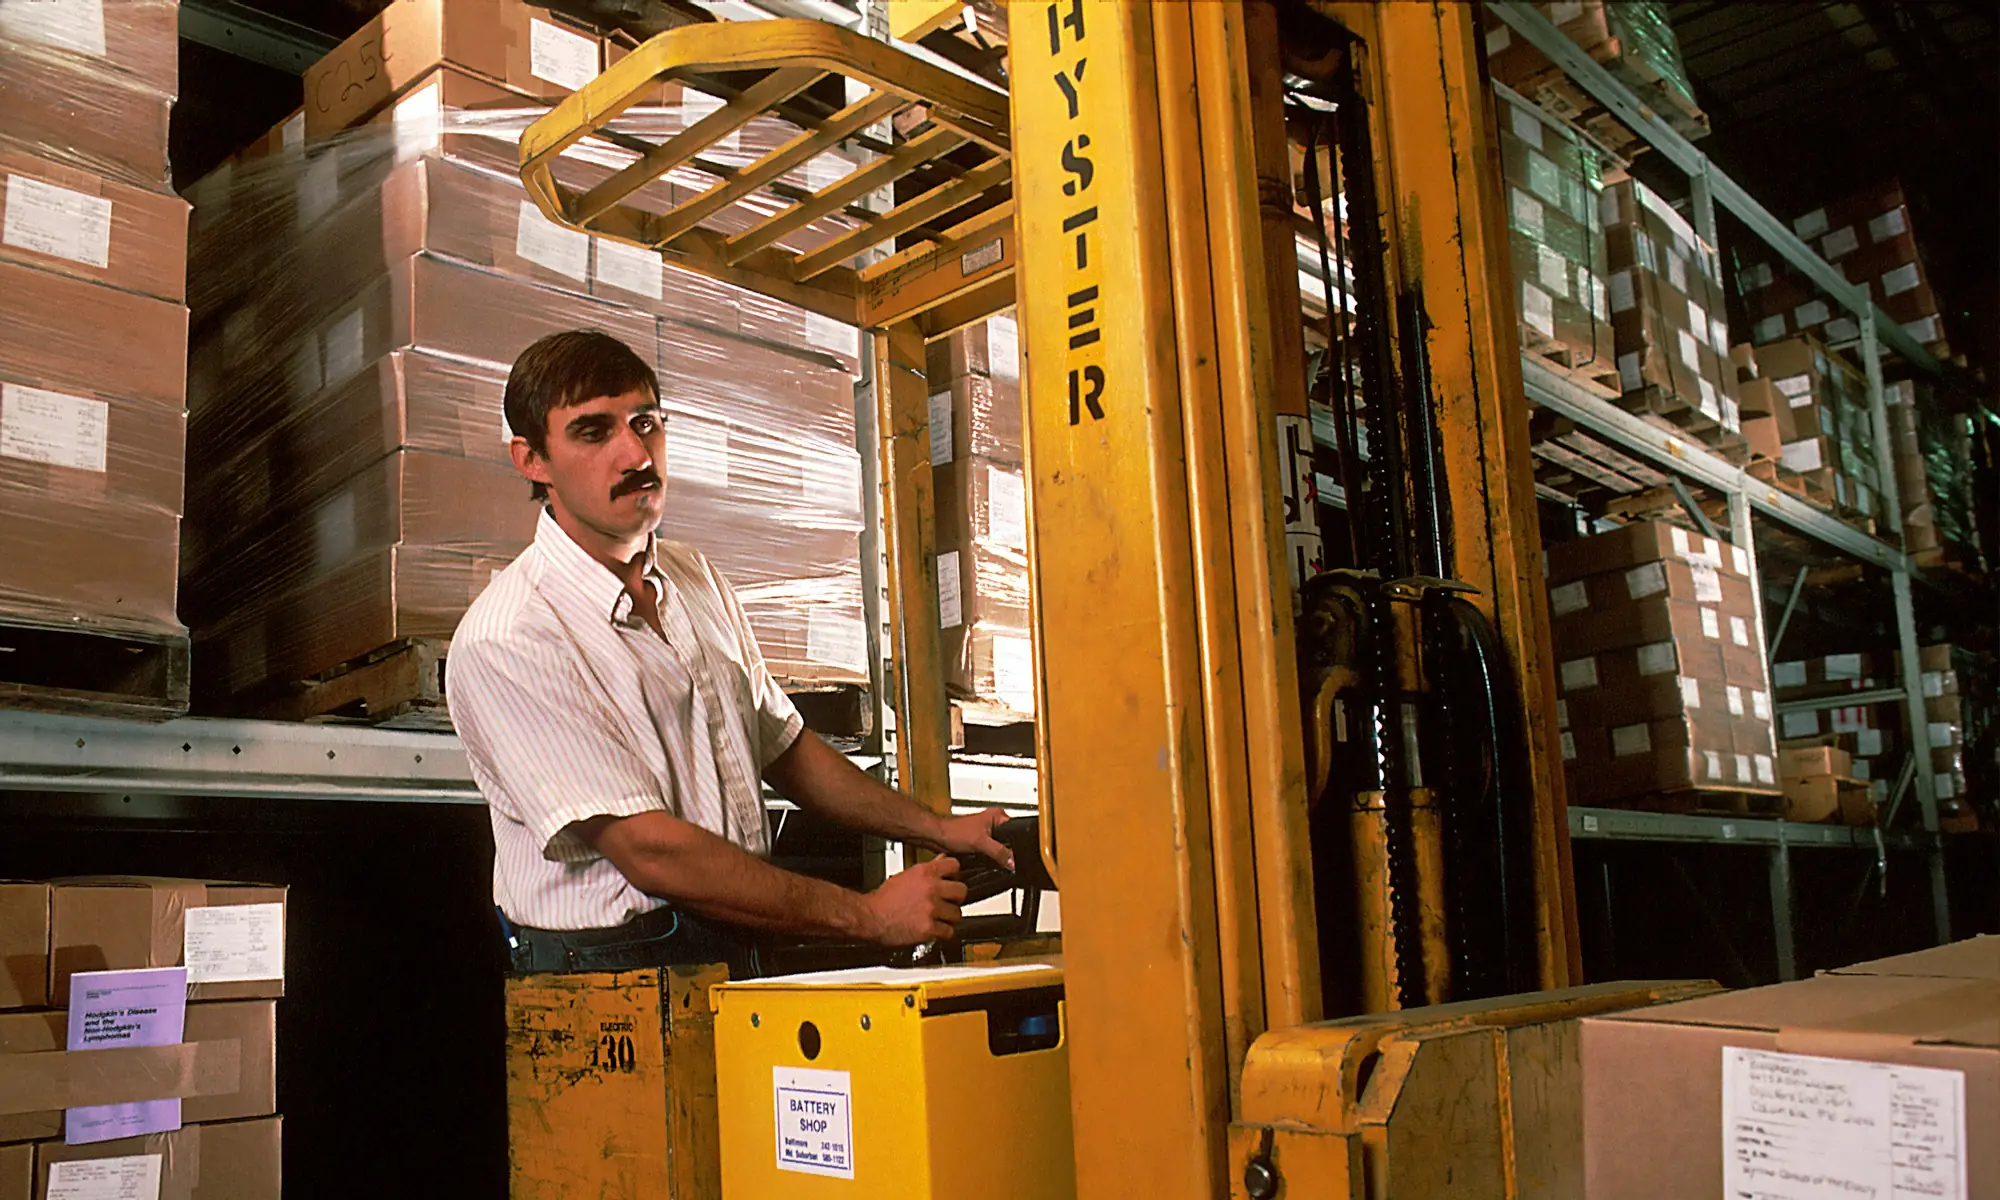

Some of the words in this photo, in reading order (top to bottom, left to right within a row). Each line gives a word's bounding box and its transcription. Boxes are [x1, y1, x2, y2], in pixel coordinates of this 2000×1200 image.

[1046, 0, 1106, 427] HYSTER
[84, 1009, 125, 1019] Hodgkin's
[127, 1007, 158, 1016] Disease
[84, 1023, 141, 1034] Non-Hodgkin's
[83, 1031, 131, 1043] Lymphomas
[790, 1098, 836, 1116] BATTERY
[799, 1118, 828, 1133] SHOP
[785, 1137, 808, 1148] Baltimore
